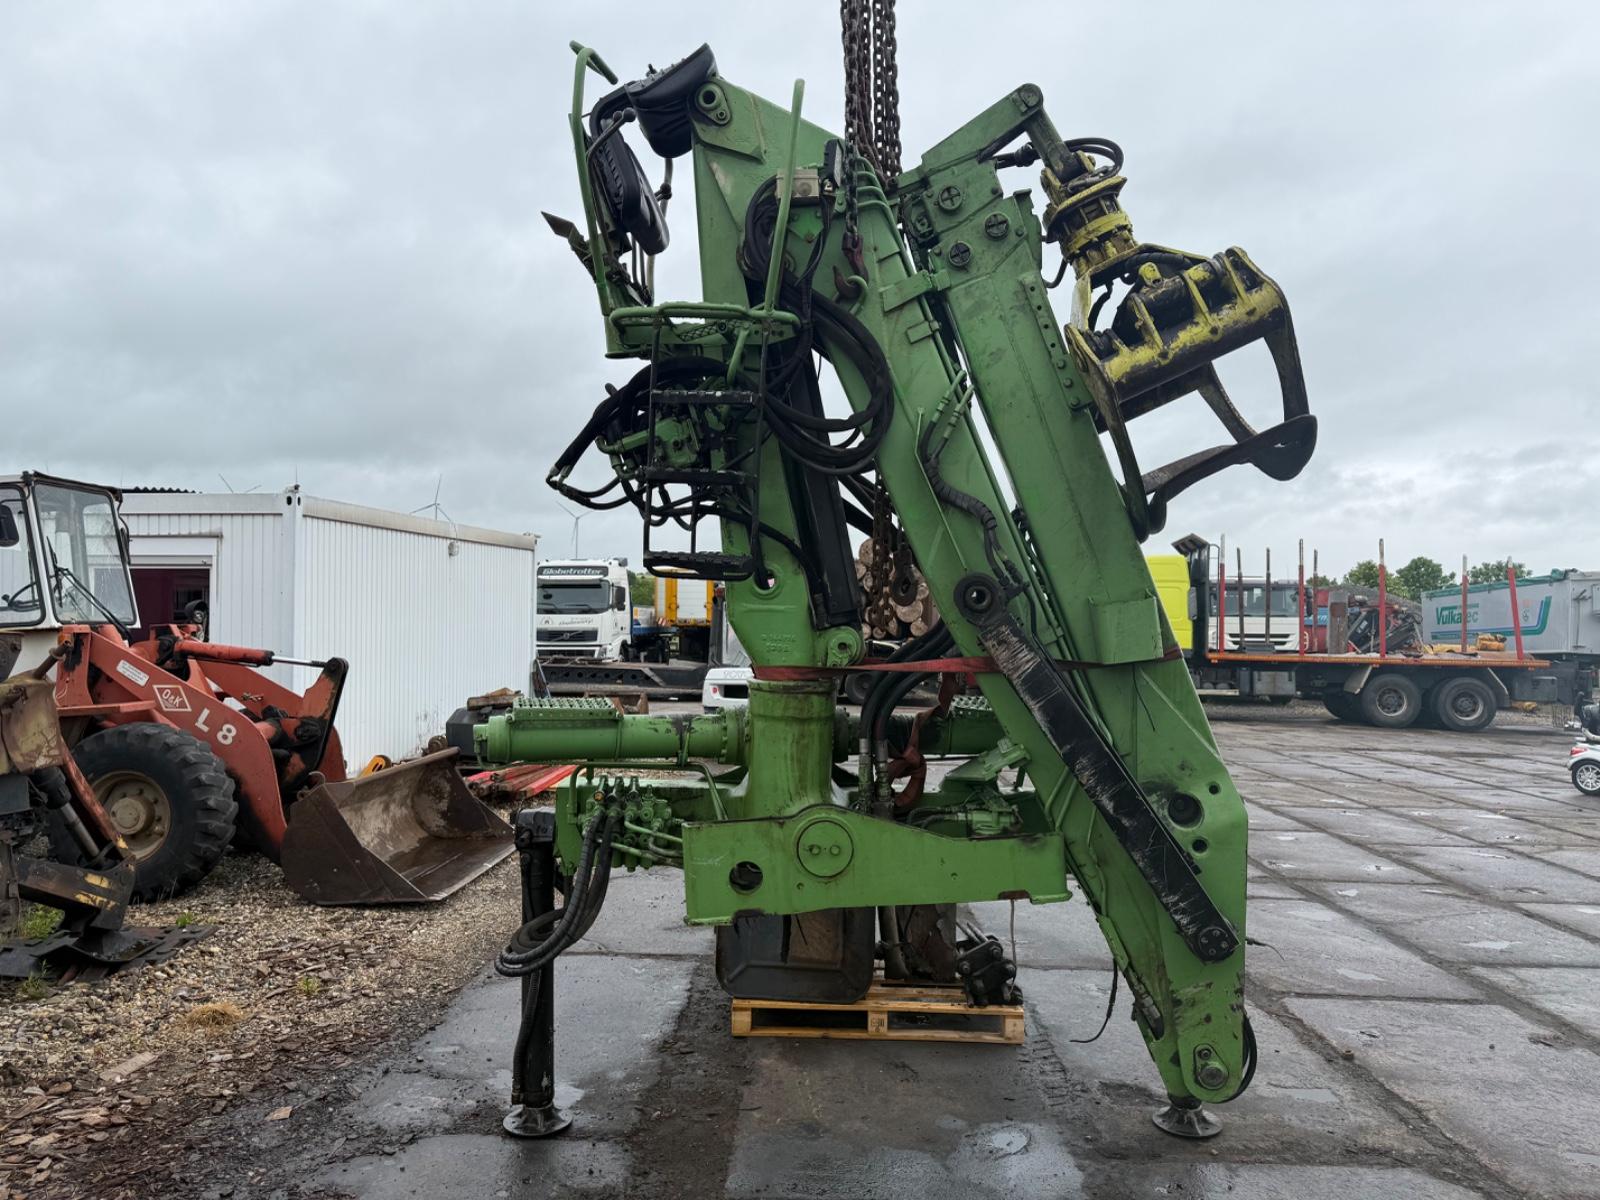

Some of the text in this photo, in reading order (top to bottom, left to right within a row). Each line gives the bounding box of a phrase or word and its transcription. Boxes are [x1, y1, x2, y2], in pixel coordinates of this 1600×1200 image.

[1435, 605, 1479, 625] Vulkaec
[162, 689, 183, 708] O&K
[194, 707, 237, 745] L 8
